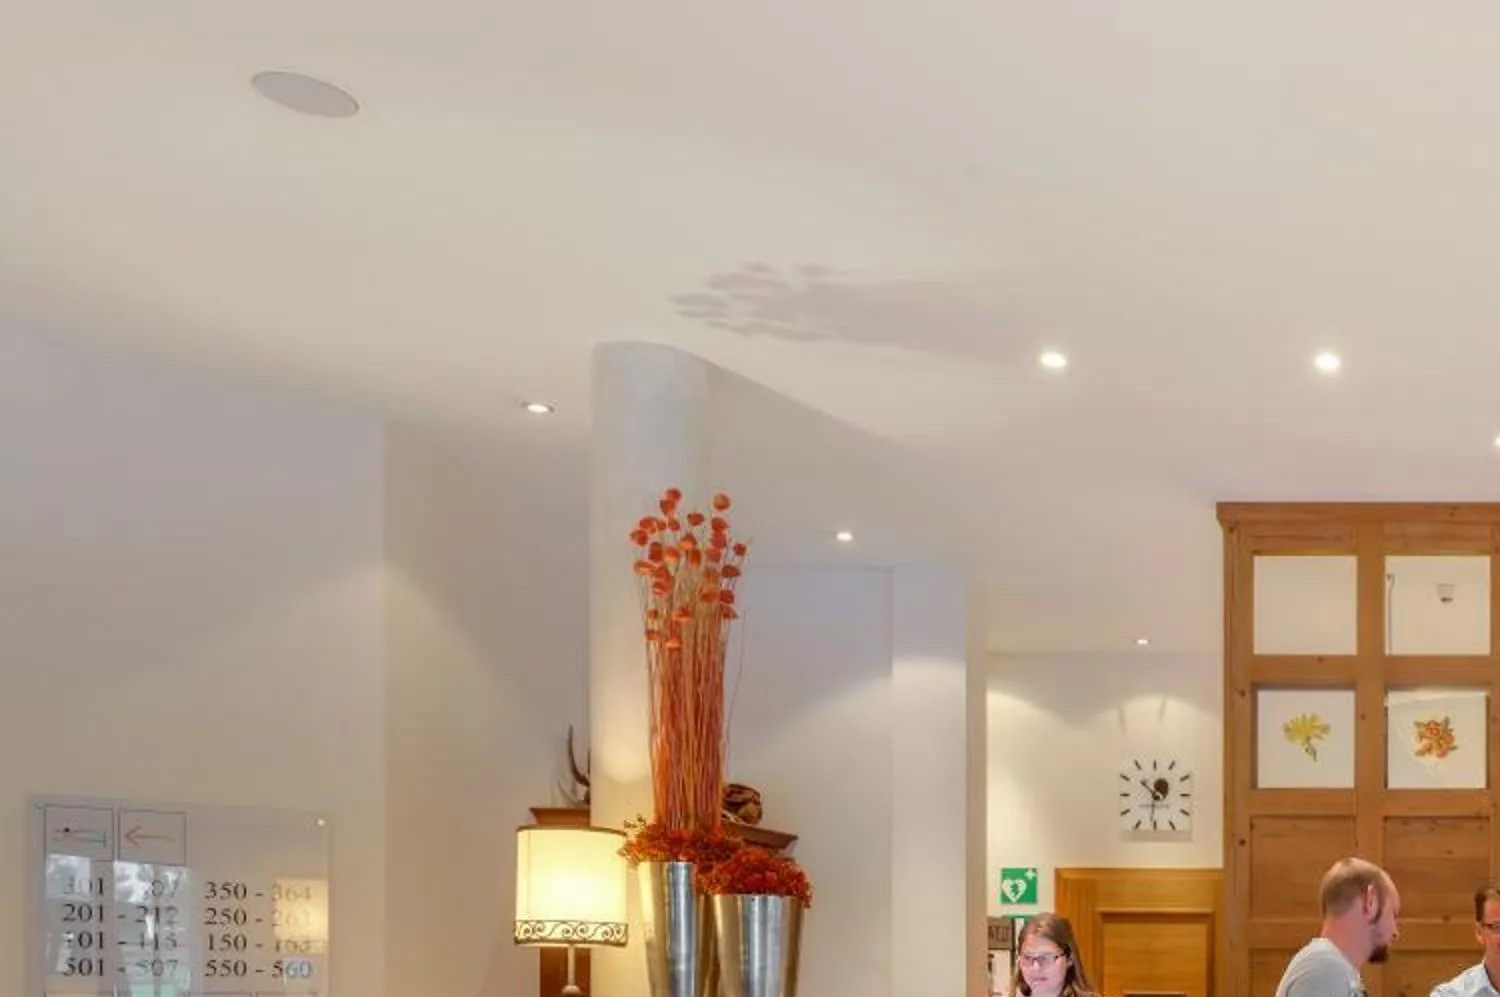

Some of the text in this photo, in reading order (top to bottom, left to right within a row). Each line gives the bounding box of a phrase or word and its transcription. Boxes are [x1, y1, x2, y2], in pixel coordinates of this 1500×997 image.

[203, 880, 248, 901] 350
[61, 902, 105, 924] 201
[203, 906, 248, 927] 250
[207, 931, 248, 952] 150
[62, 956, 105, 977] 501
[204, 959, 248, 978] 550
[271, 958, 314, 979] 560
